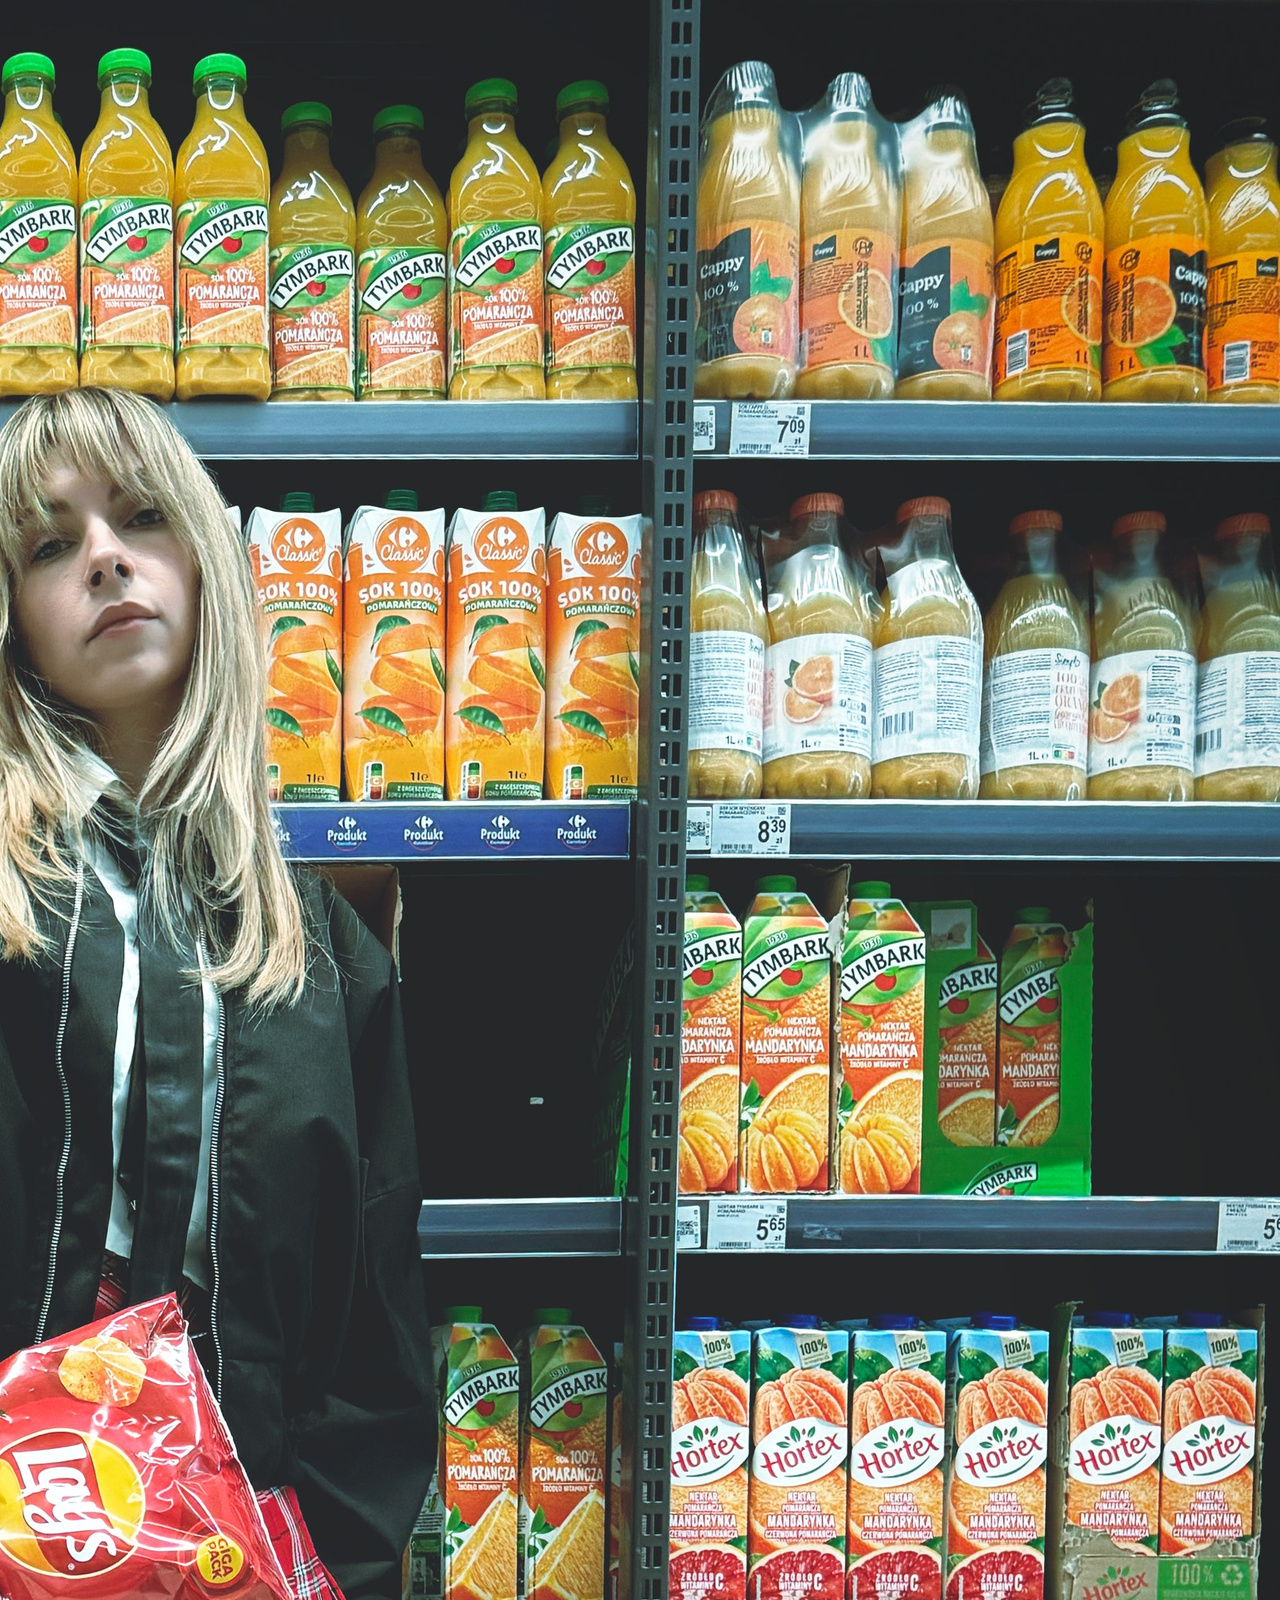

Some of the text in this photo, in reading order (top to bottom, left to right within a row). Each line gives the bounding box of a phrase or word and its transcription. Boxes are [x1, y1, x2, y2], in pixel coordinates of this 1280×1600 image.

[186, 207, 264, 254] TYMBARK
[460, 229, 538, 278] TYMBARK
[552, 230, 630, 282] TYMBARK
[226, 267, 255, 283] 100%
[700, 254, 745, 280] Cappy
[189, 282, 259, 300] POMARAŃCZA
[500, 288, 528, 304] 100%
[899, 272, 945, 297] Cappy
[463, 304, 533, 321] POMARAŃCZA
[380, 541, 427, 563] Classic
[358, 581, 442, 607] SOK 100%
[365, 598, 439, 615] POMARAŃCZOWY
[744, 937, 829, 988] TYMBARK
[842, 942, 925, 994] TYMBARK
[764, 1025, 822, 1038] POMARAŃCZA
[745, 1038, 825, 1053] MANDARYNKA
[799, 1339, 828, 1357] 100%
[446, 1366, 519, 1419] TYMBARK
[761, 1433, 842, 1478] Hortex
[447, 1463, 516, 1483] POMARAŃCZA
[787, 1492, 817, 1503] NEKTAR
[767, 1514, 835, 1528] MANDARYNKA
[206, 1540, 222, 1581] PACK
[216, 1537, 235, 1579] GIGA
